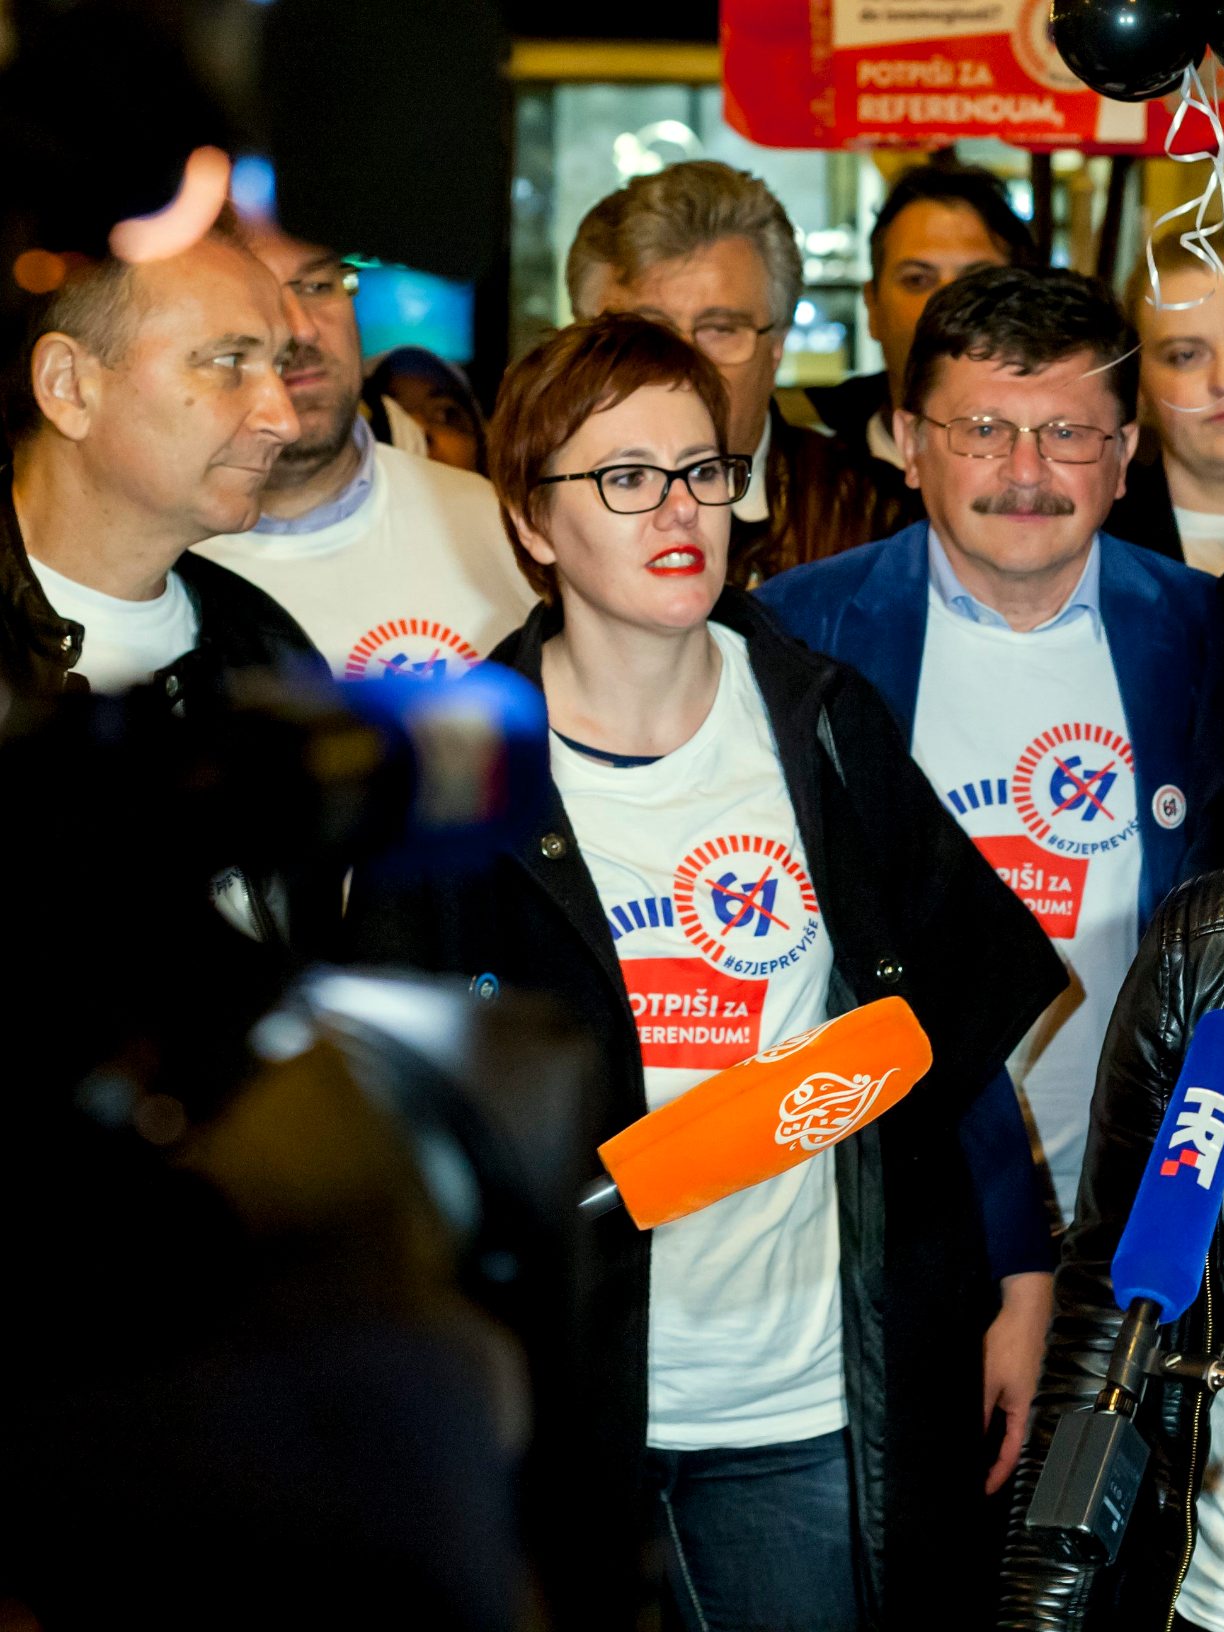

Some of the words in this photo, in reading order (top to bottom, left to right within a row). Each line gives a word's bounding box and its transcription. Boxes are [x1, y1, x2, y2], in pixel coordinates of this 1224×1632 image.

[958, 59, 994, 86] ZA
[1049, 755, 1118, 822] 67
[1047, 818, 1140, 855] #67JEPREVIŠ
[996, 862, 1044, 891] PIŠI
[1047, 876, 1072, 892] ZA
[711, 871, 778, 937] 67
[723, 917, 819, 976] #67JEPREVIŠE
[629, 988, 719, 1018] OTPIŠI
[722, 1001, 749, 1018] ZA
[637, 1026, 750, 1045] ERENDUM!
